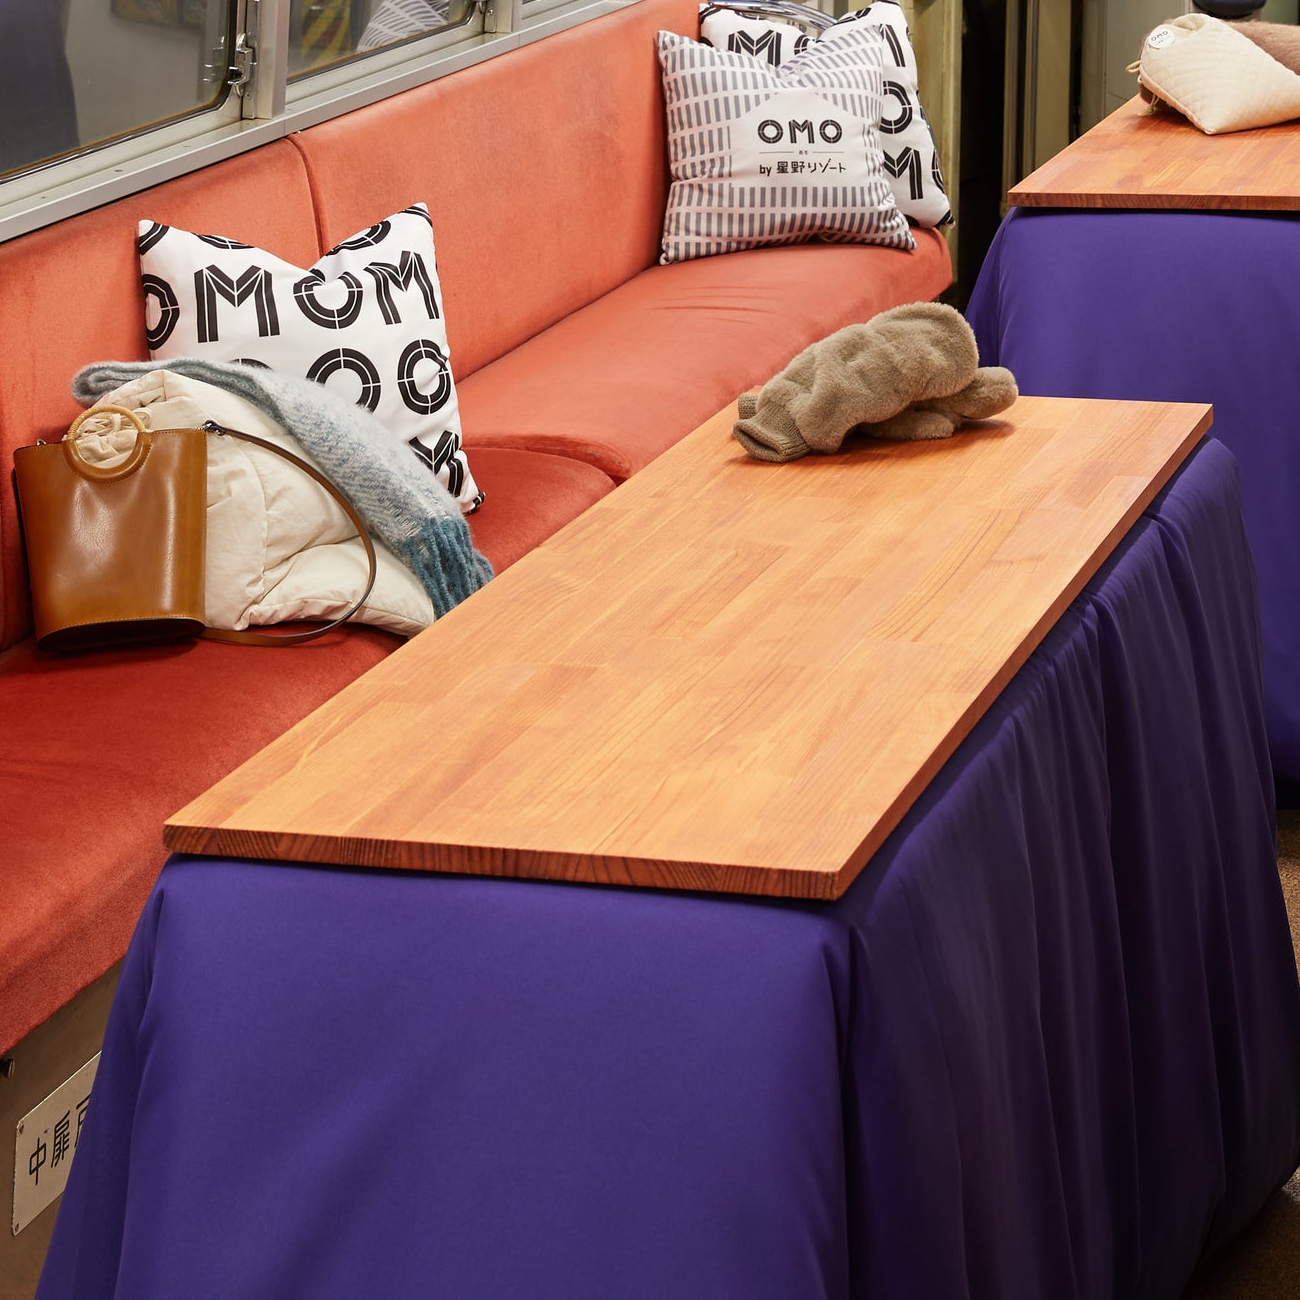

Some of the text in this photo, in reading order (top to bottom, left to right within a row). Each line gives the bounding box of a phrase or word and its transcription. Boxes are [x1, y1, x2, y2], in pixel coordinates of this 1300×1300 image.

[758, 119, 842, 144] OMO
[759, 157, 847, 176] by 星野リゾート
